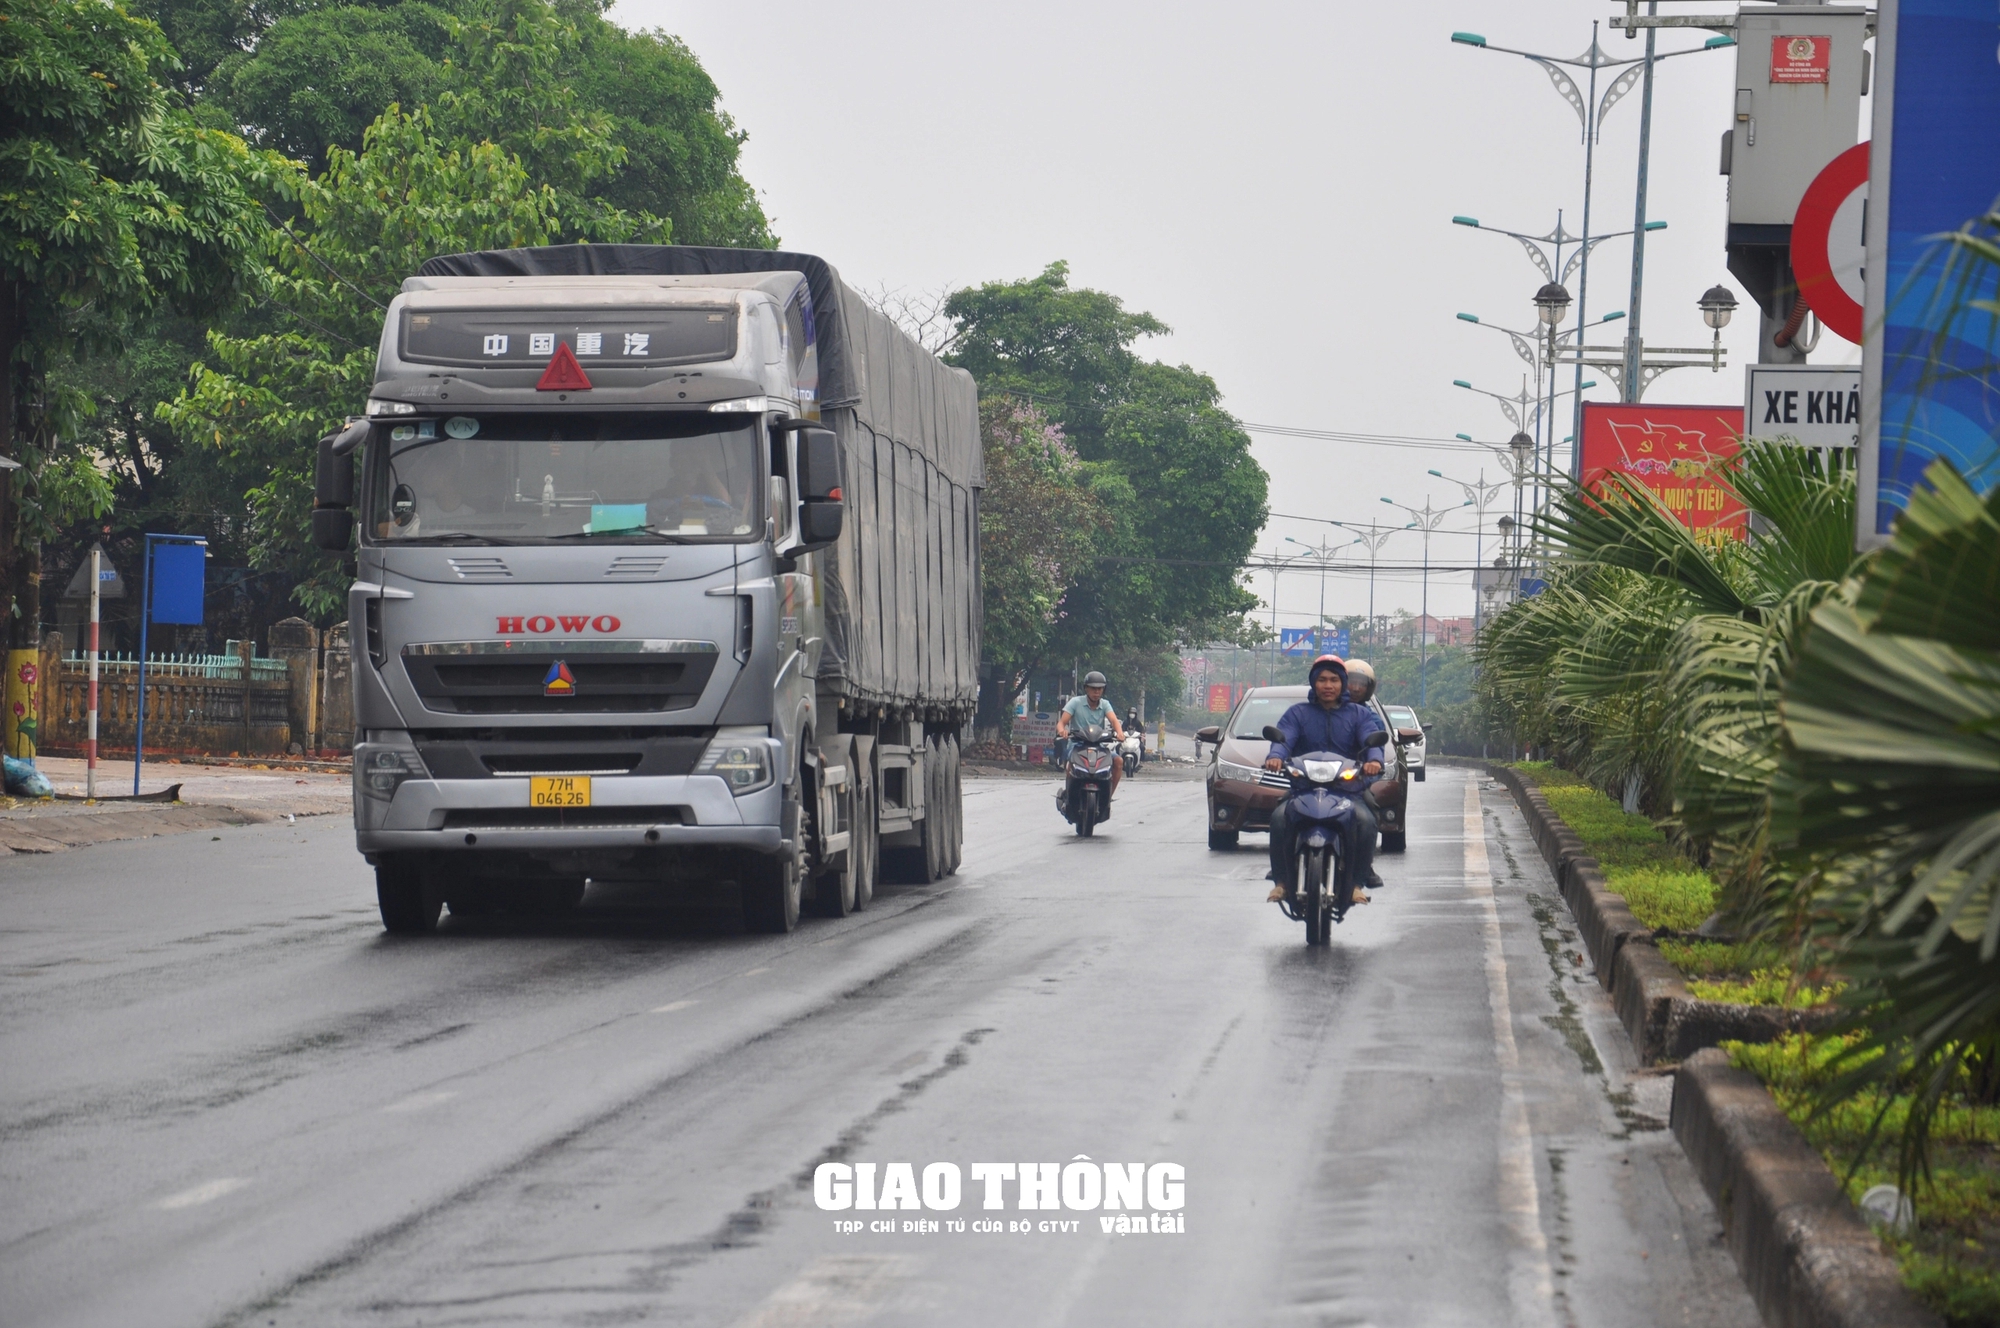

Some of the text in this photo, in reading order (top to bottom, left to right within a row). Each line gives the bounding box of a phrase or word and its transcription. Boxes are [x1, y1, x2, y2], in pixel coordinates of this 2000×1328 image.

[483, 333, 650, 356] 中国重汽
[1764, 390, 1798, 424] XE
[1664, 487, 1694, 516] MỤC
[1696, 484, 1725, 511] TIÊU
[496, 615, 621, 634] HOWO
[548, 778, 573, 791] 77H
[537, 792, 584, 805] 046.26
